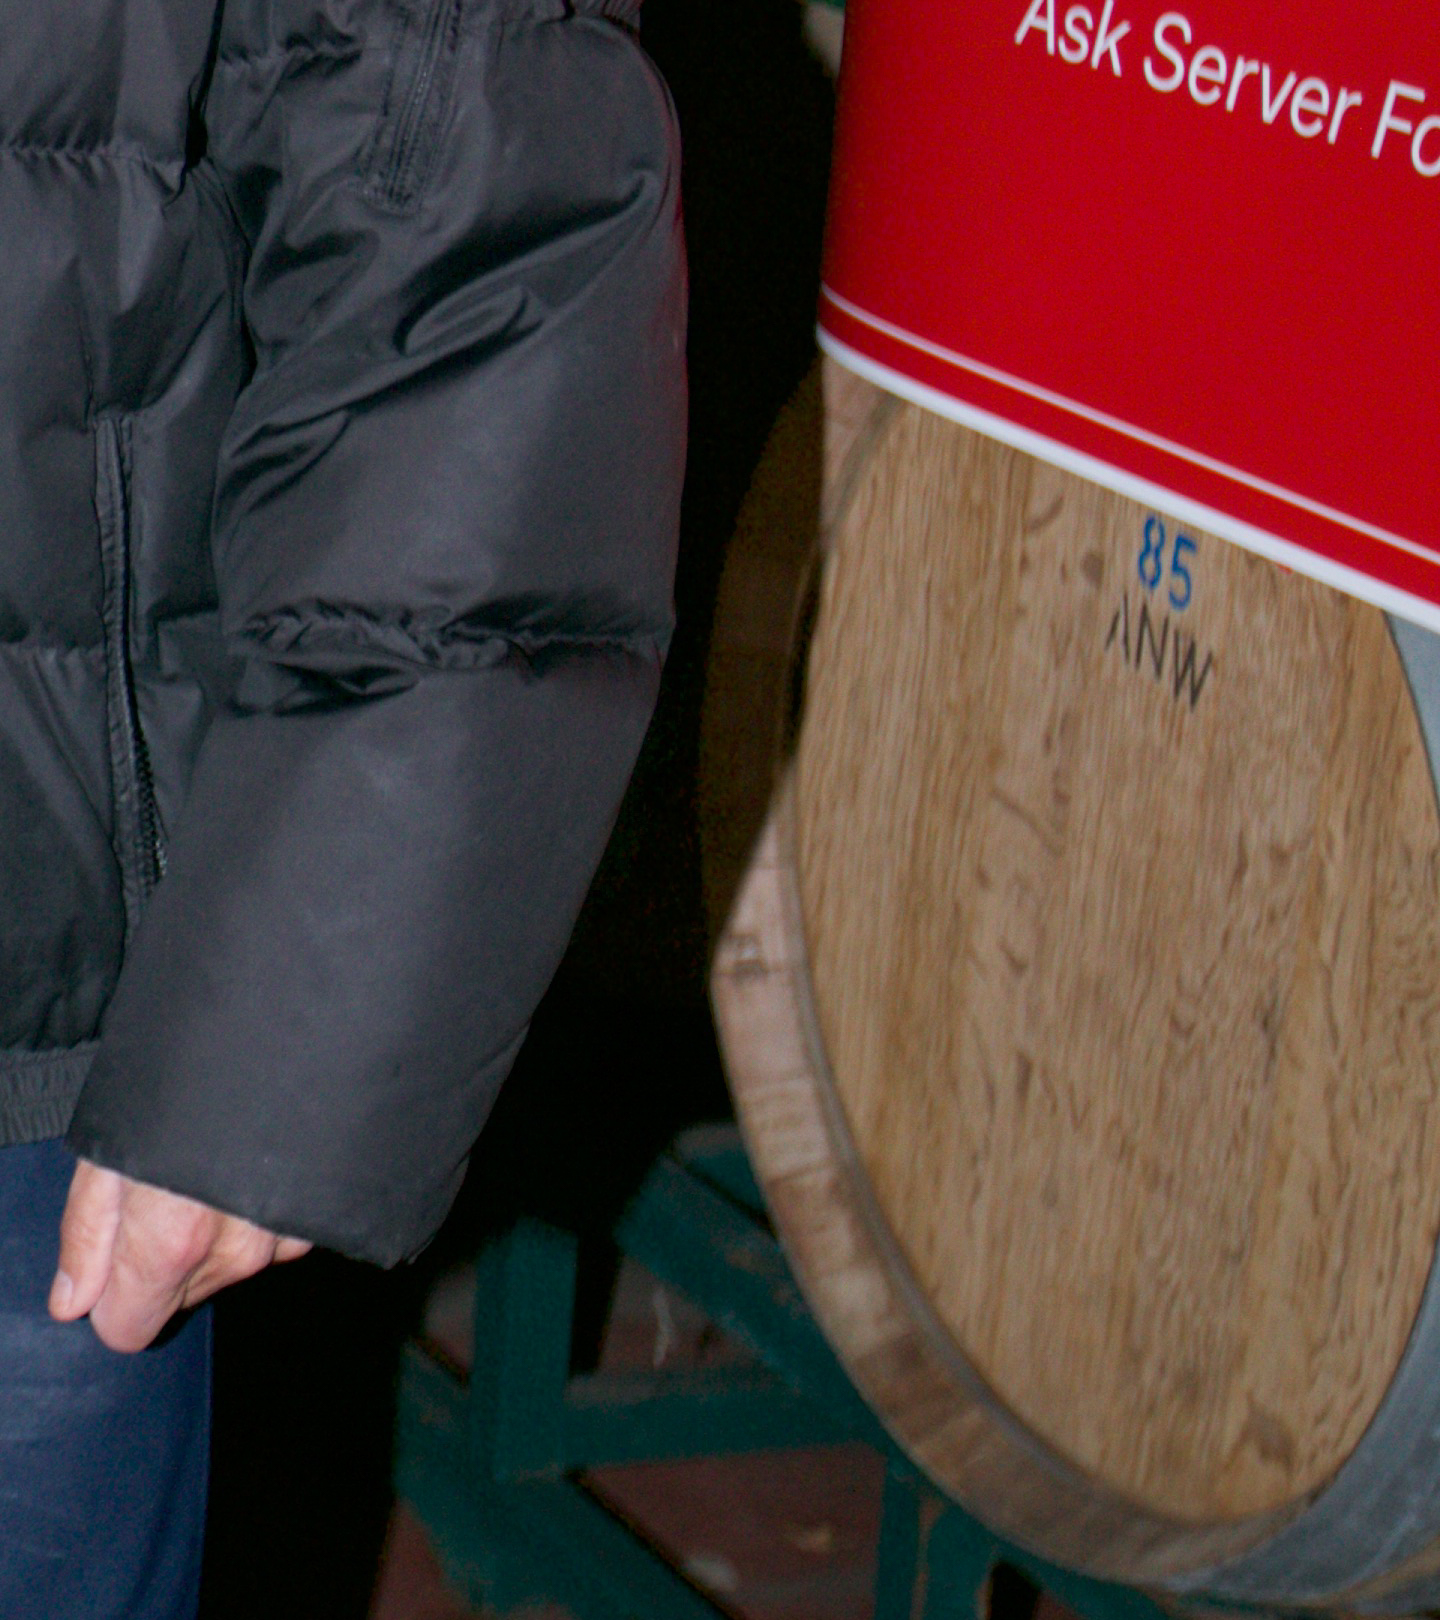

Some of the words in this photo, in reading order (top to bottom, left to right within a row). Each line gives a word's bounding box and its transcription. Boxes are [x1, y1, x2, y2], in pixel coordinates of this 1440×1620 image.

[1143, 11, 1363, 145] Server
[1137, 515, 1197, 610] 85
[1105, 590, 1213, 713] ANW
